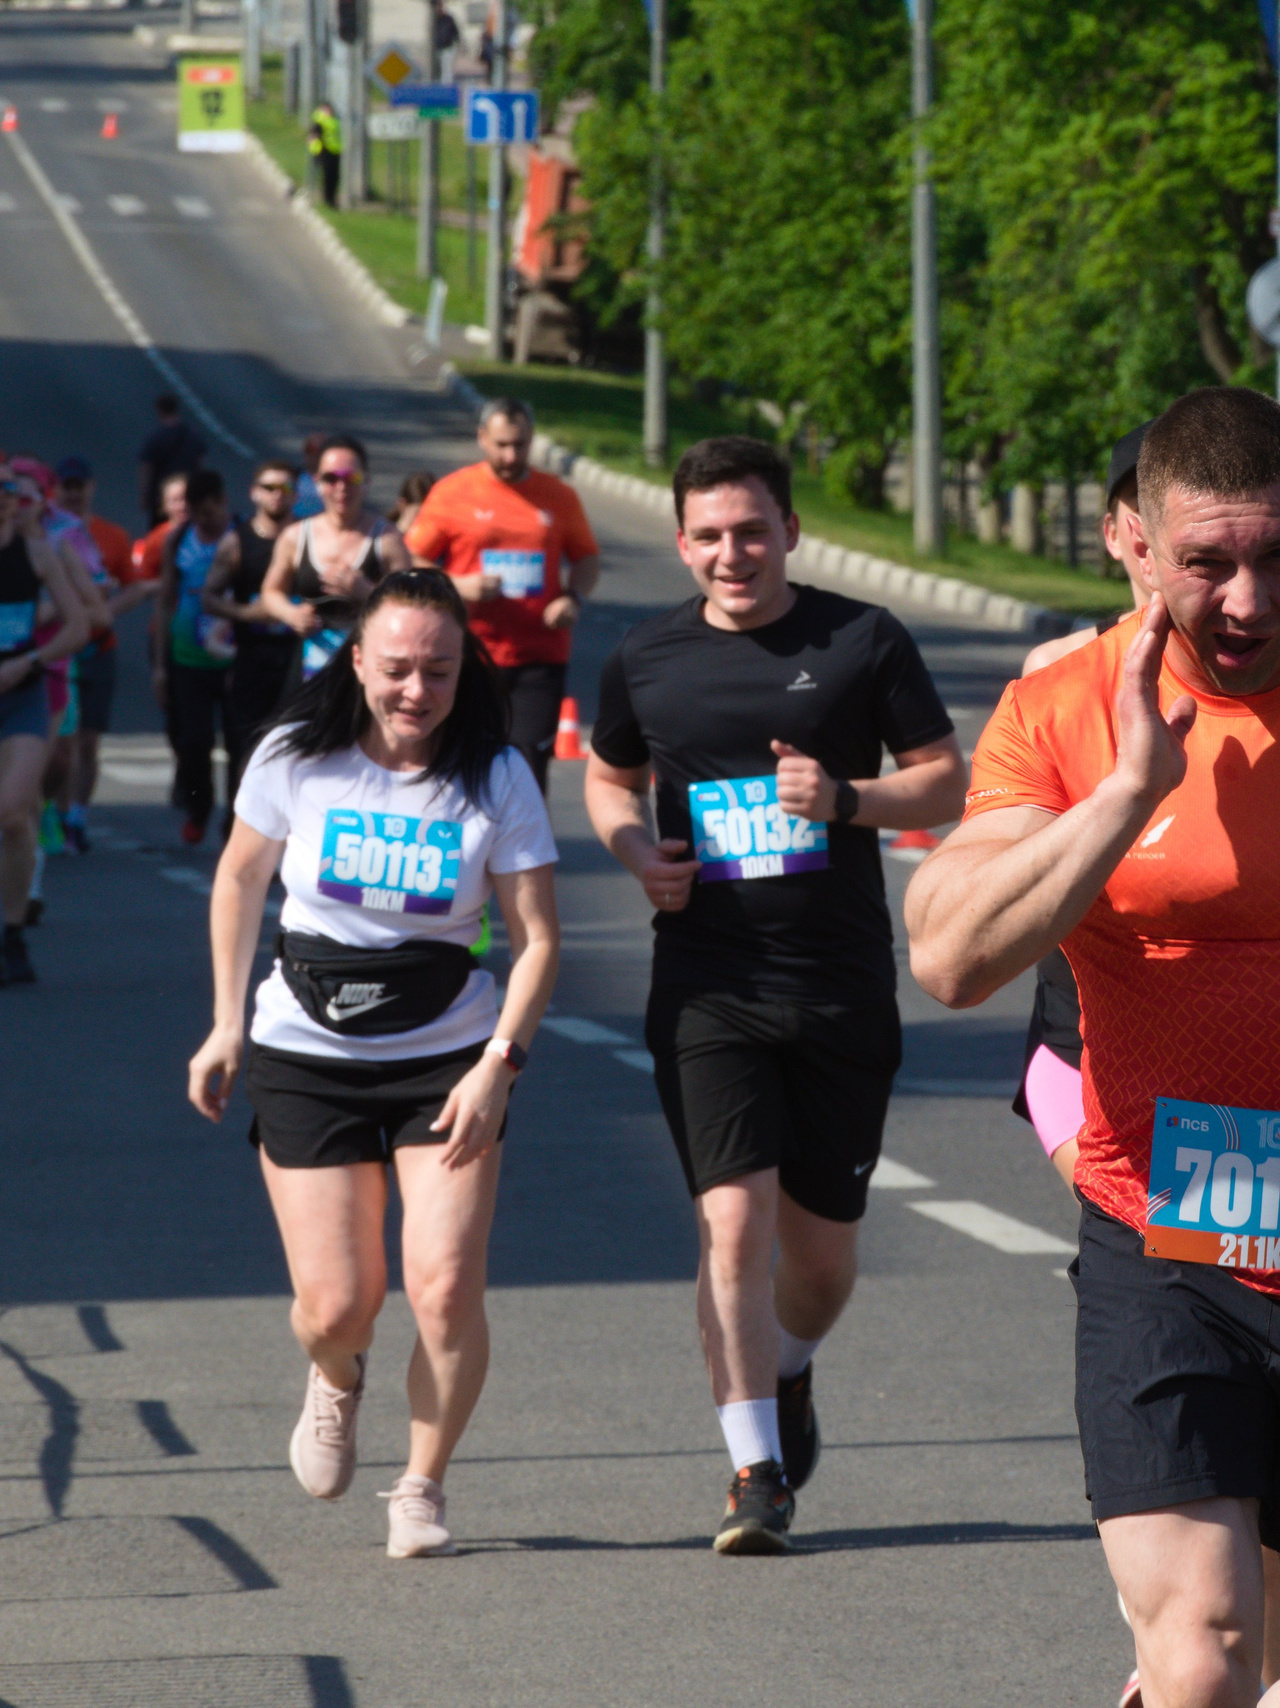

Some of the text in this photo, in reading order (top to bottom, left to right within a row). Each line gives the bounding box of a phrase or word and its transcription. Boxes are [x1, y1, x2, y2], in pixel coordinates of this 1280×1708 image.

[743, 780, 768, 804] 10
[383, 816, 408, 839] 10
[703, 802, 815, 858] 50132
[333, 832, 443, 893] 50113
[336, 982, 387, 1005] NIKE
[1180, 1117, 1210, 1132] ПСБ
